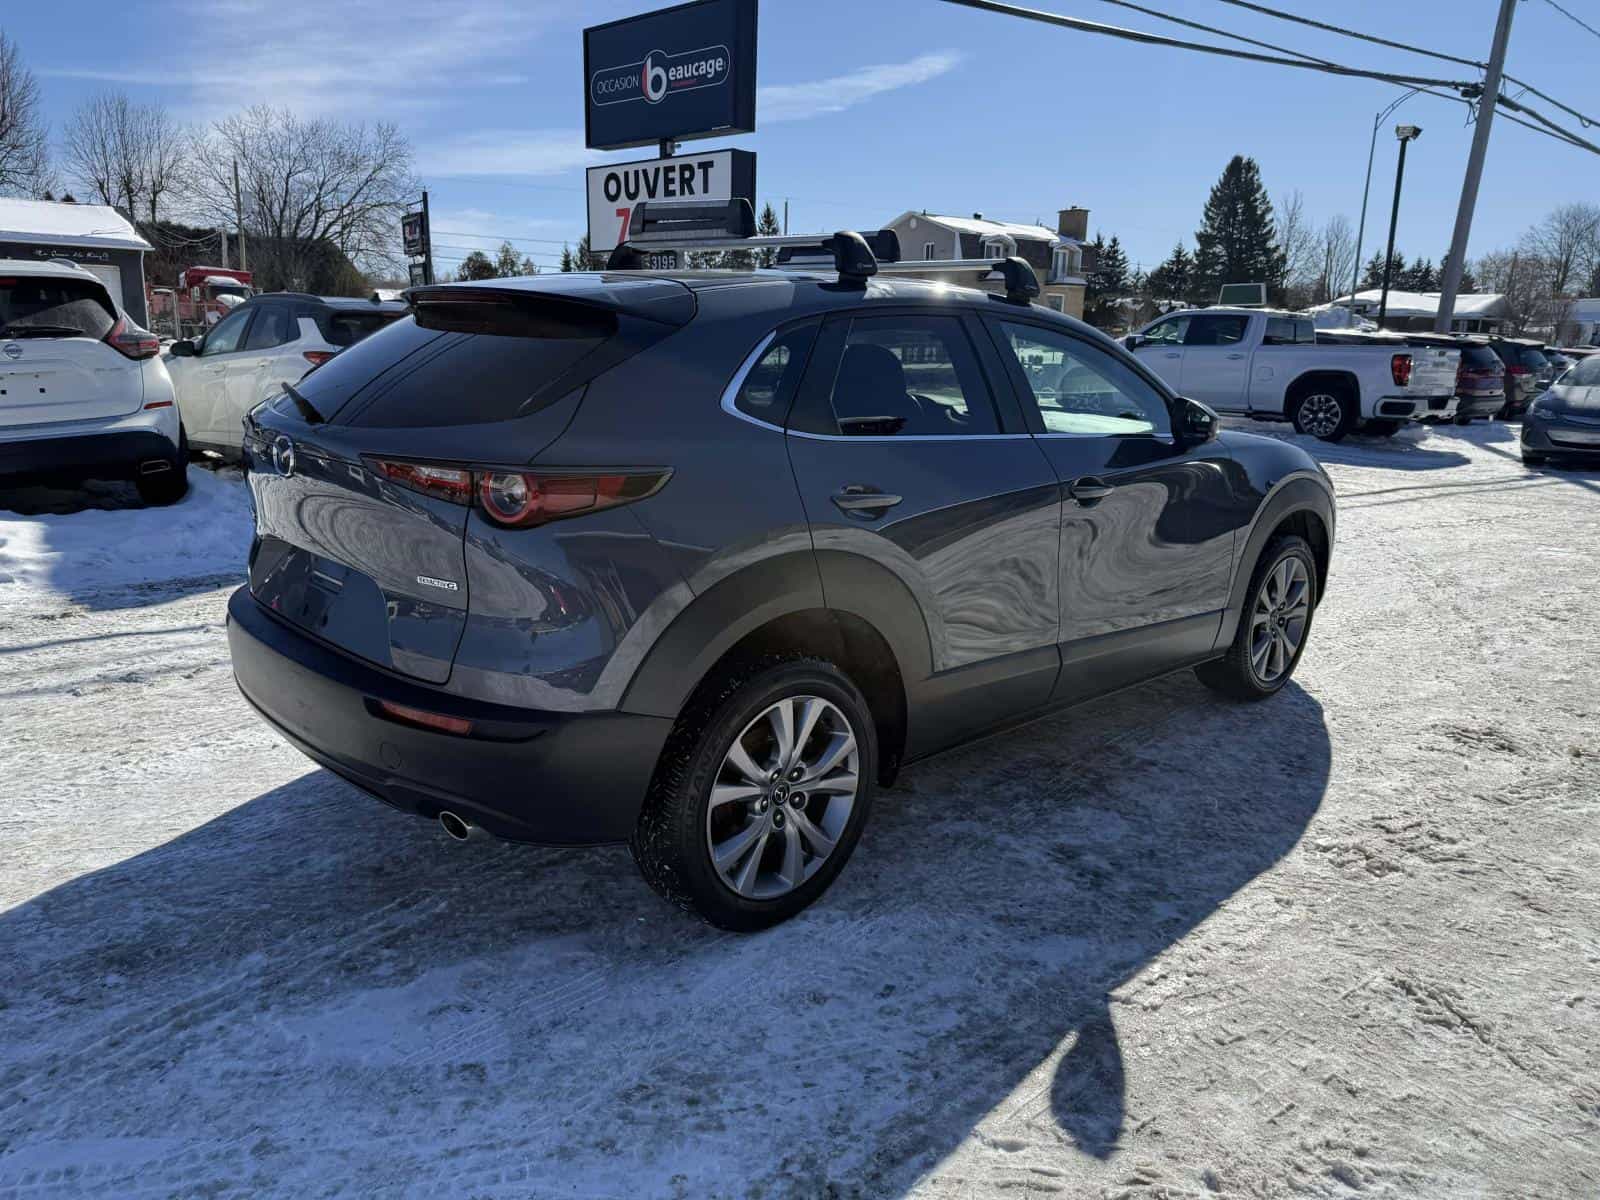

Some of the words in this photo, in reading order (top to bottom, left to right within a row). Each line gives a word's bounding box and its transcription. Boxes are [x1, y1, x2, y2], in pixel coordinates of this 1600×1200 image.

[597, 75, 639, 94] OCCASION
[604, 161, 714, 202] OUVERT
[616, 207, 631, 246] 7
[651, 255, 676, 270] 3195
